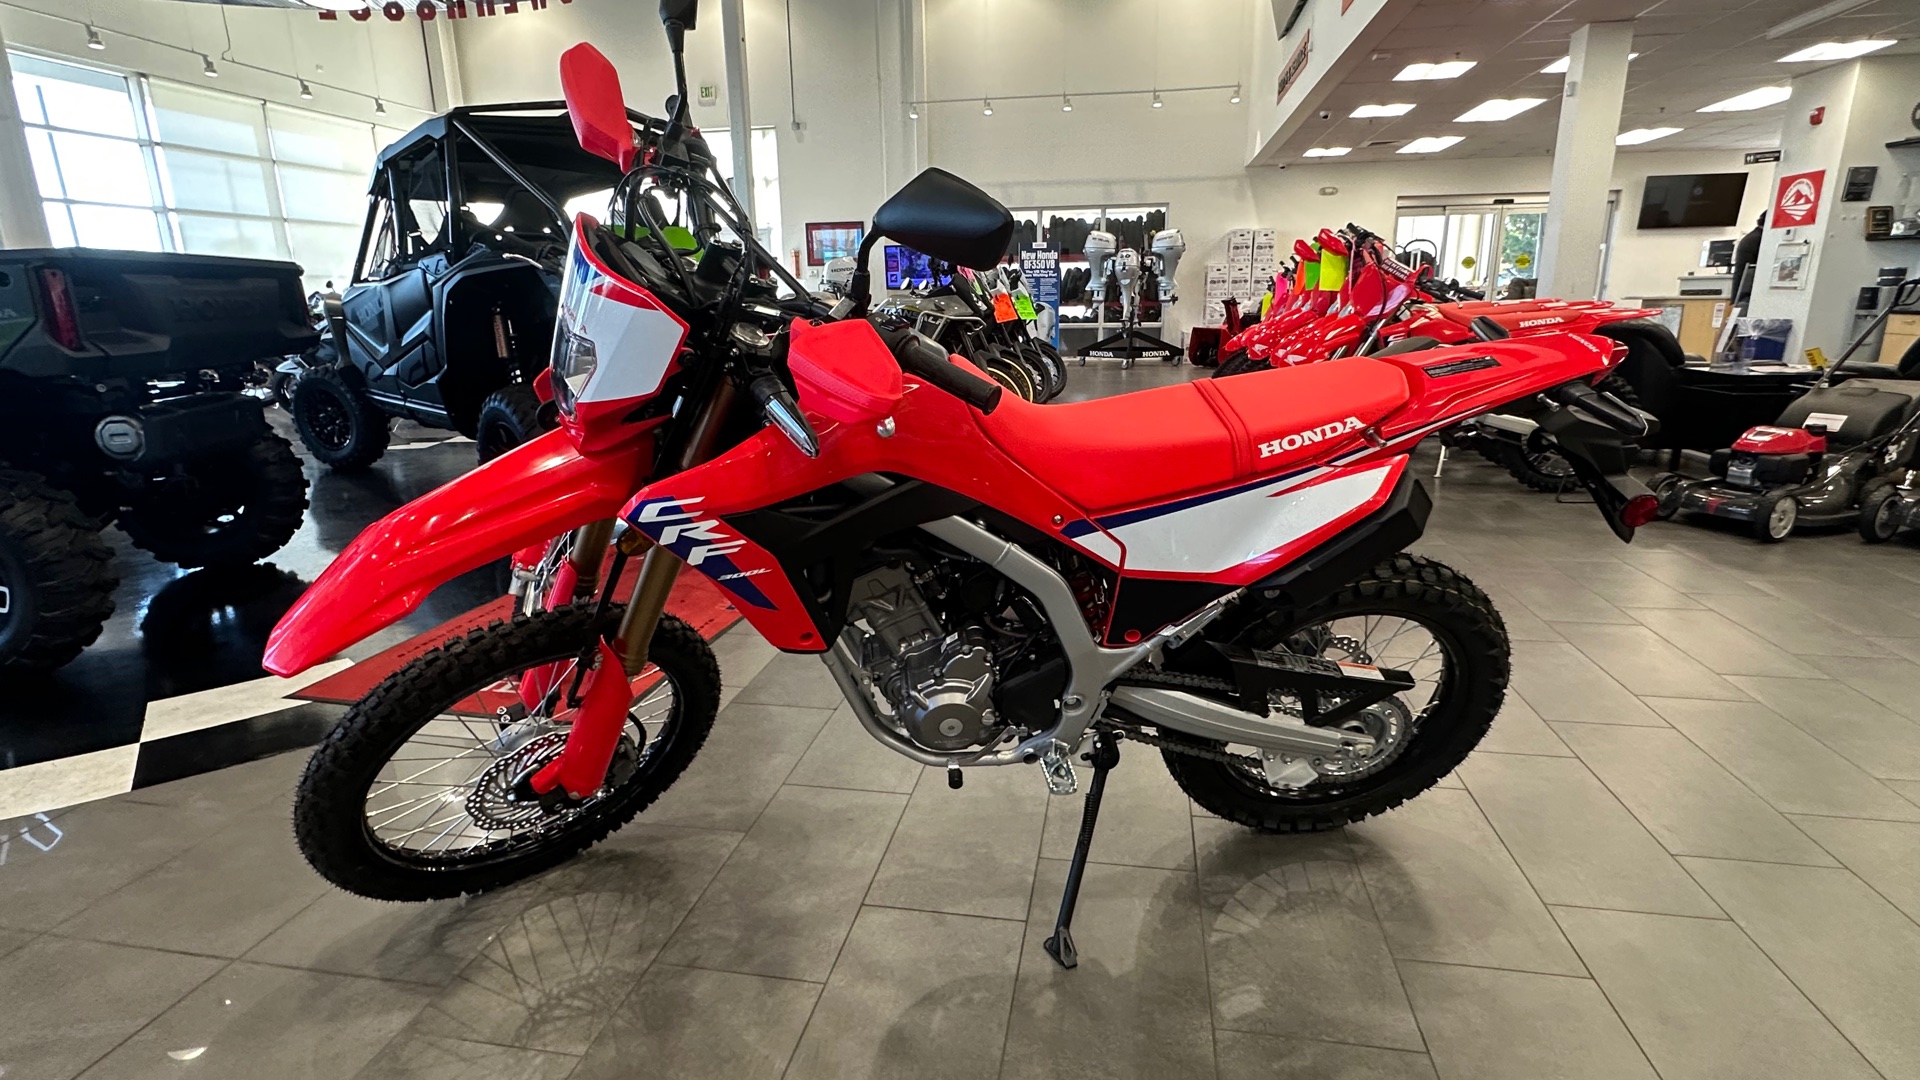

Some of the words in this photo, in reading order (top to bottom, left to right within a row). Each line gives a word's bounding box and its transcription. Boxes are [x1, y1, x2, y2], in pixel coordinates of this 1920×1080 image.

[1021, 250, 1036, 260] New
[1037, 250, 1058, 260] Honda
[1518, 316, 1565, 328] HONDA
[1089, 349, 1114, 358] HONDA
[1142, 349, 1170, 358] HONDA
[1257, 416, 1367, 459] HONDA
[638, 496, 748, 566] CRF
[717, 567, 773, 581] 300L
